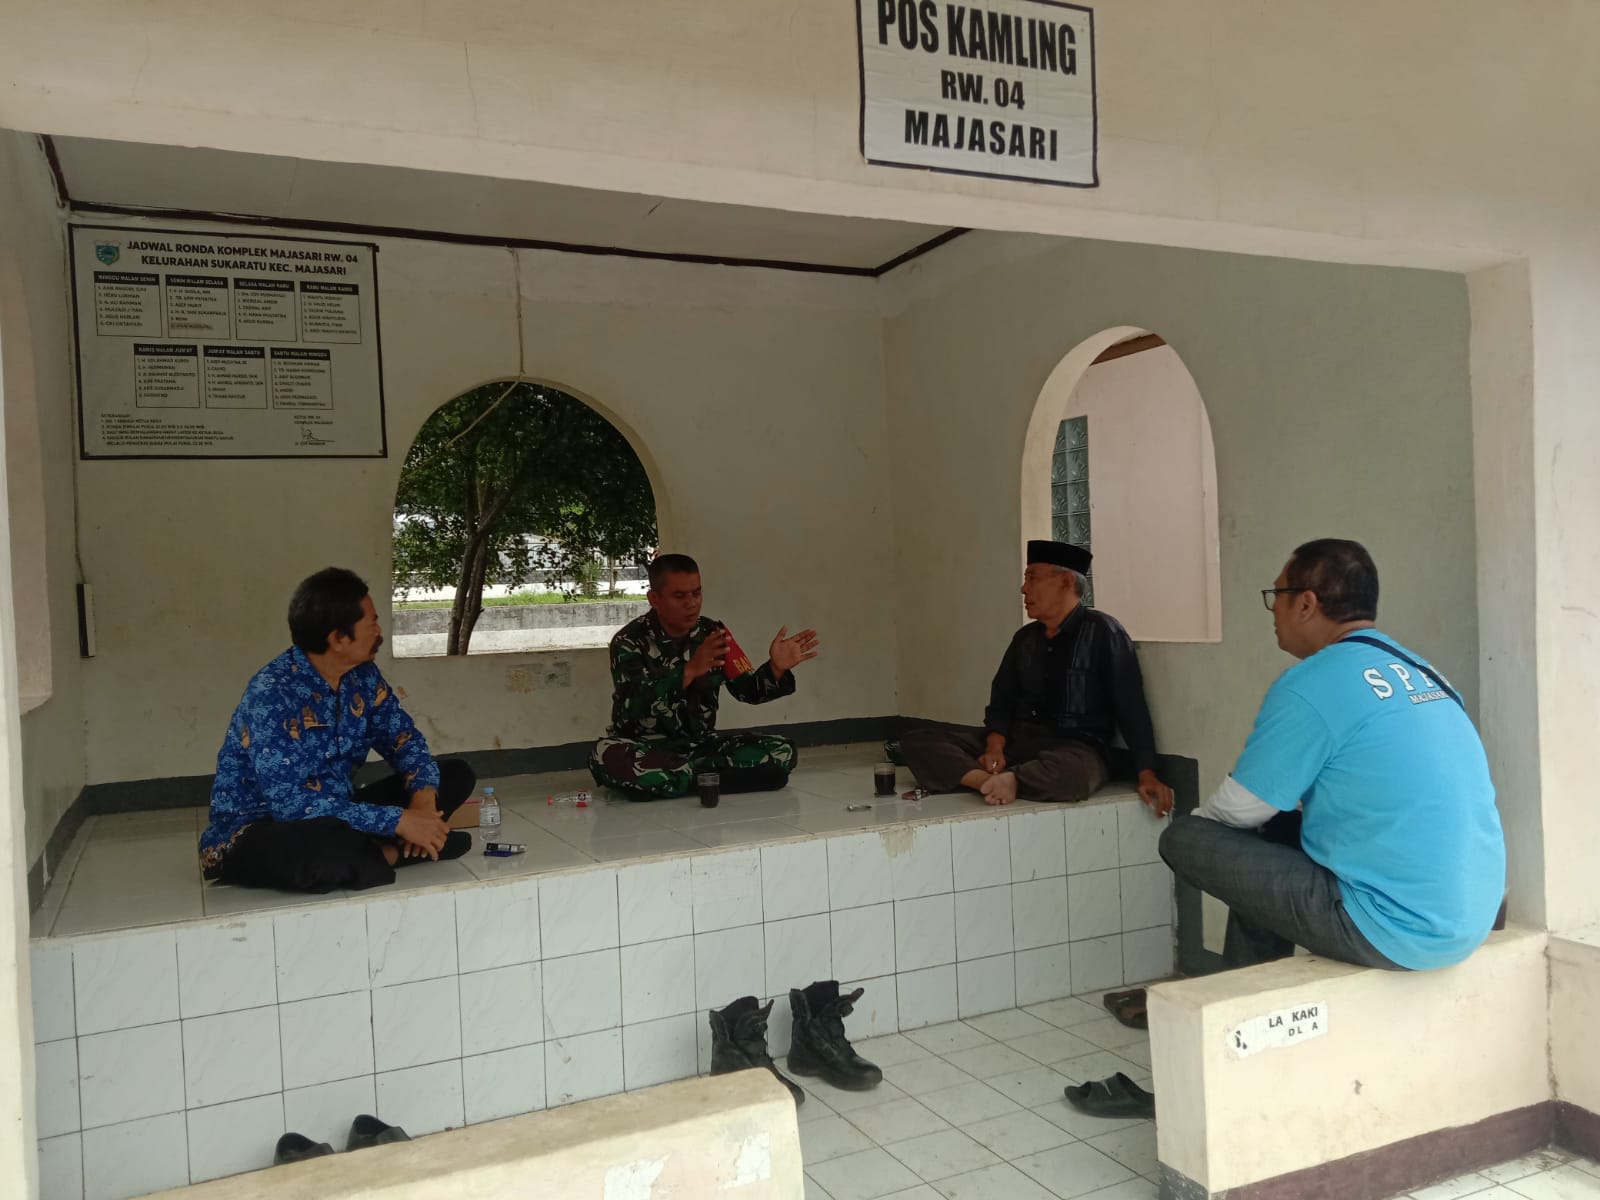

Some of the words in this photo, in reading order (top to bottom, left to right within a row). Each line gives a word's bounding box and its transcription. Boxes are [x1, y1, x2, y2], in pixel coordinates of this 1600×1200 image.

[878, 0, 939, 53] POS
[946, 4, 1077, 75] KAMLING
[941, 69, 988, 104] RW.
[994, 77, 1025, 110] 04
[904, 109, 1058, 161] MAJASARI
[127, 241, 173, 252] JADWAL
[175, 243, 215, 254] RONDA
[217, 246, 268, 257] KOMPLEK
[270, 249, 322, 261] MAJASARI
[324, 253, 343, 262] RW.
[346, 254, 358, 263] 04
[141, 255, 208, 268] KELURAHAN
[211, 259, 266, 271] SUKARATU
[269, 263, 292, 273] KEC.
[295, 265, 346, 275] MAJASARI
[1292, 1006, 1318, 1022] KAKI
